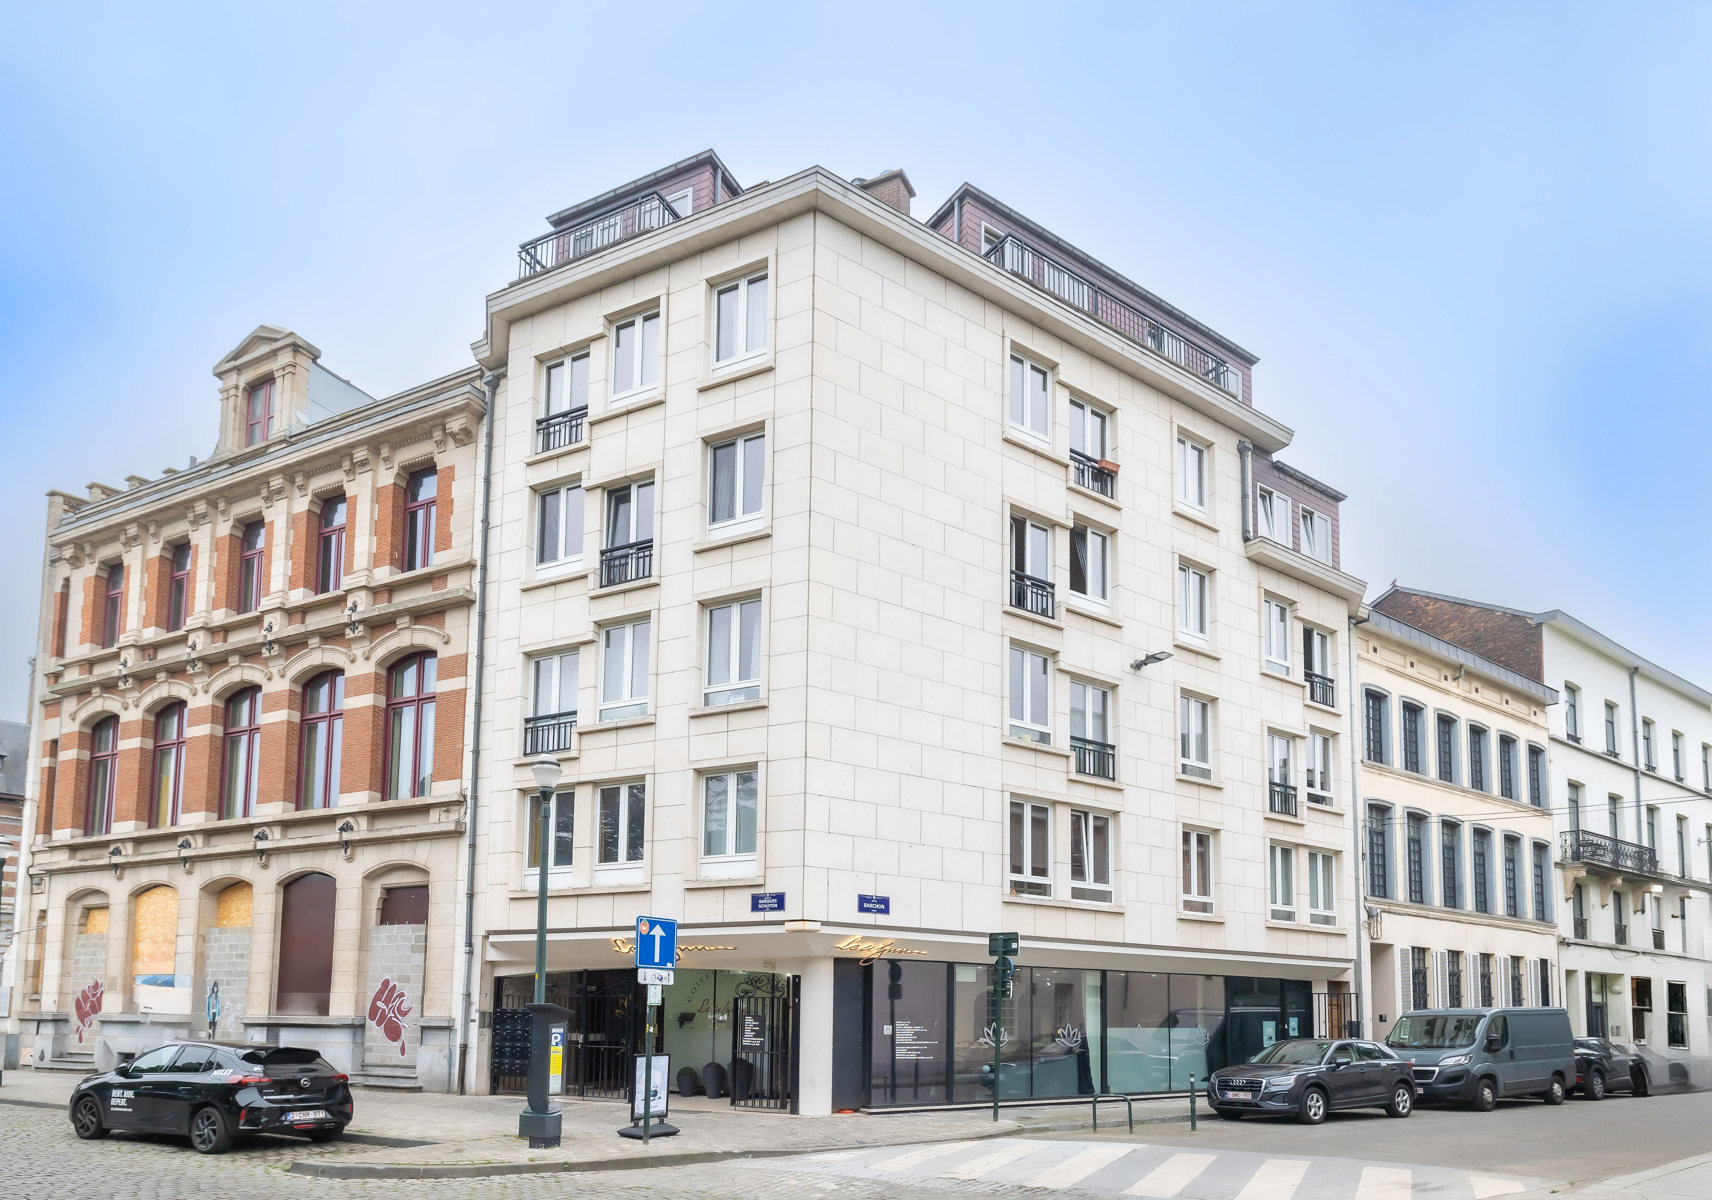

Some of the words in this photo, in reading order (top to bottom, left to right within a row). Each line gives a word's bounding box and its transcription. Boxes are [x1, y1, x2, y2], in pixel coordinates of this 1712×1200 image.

[211, 1069, 233, 1077] MILES
[111, 1089, 123, 1098] RENT.
[123, 1090, 135, 1099] RIDE.
[110, 1098, 128, 1106] REPEAT.
